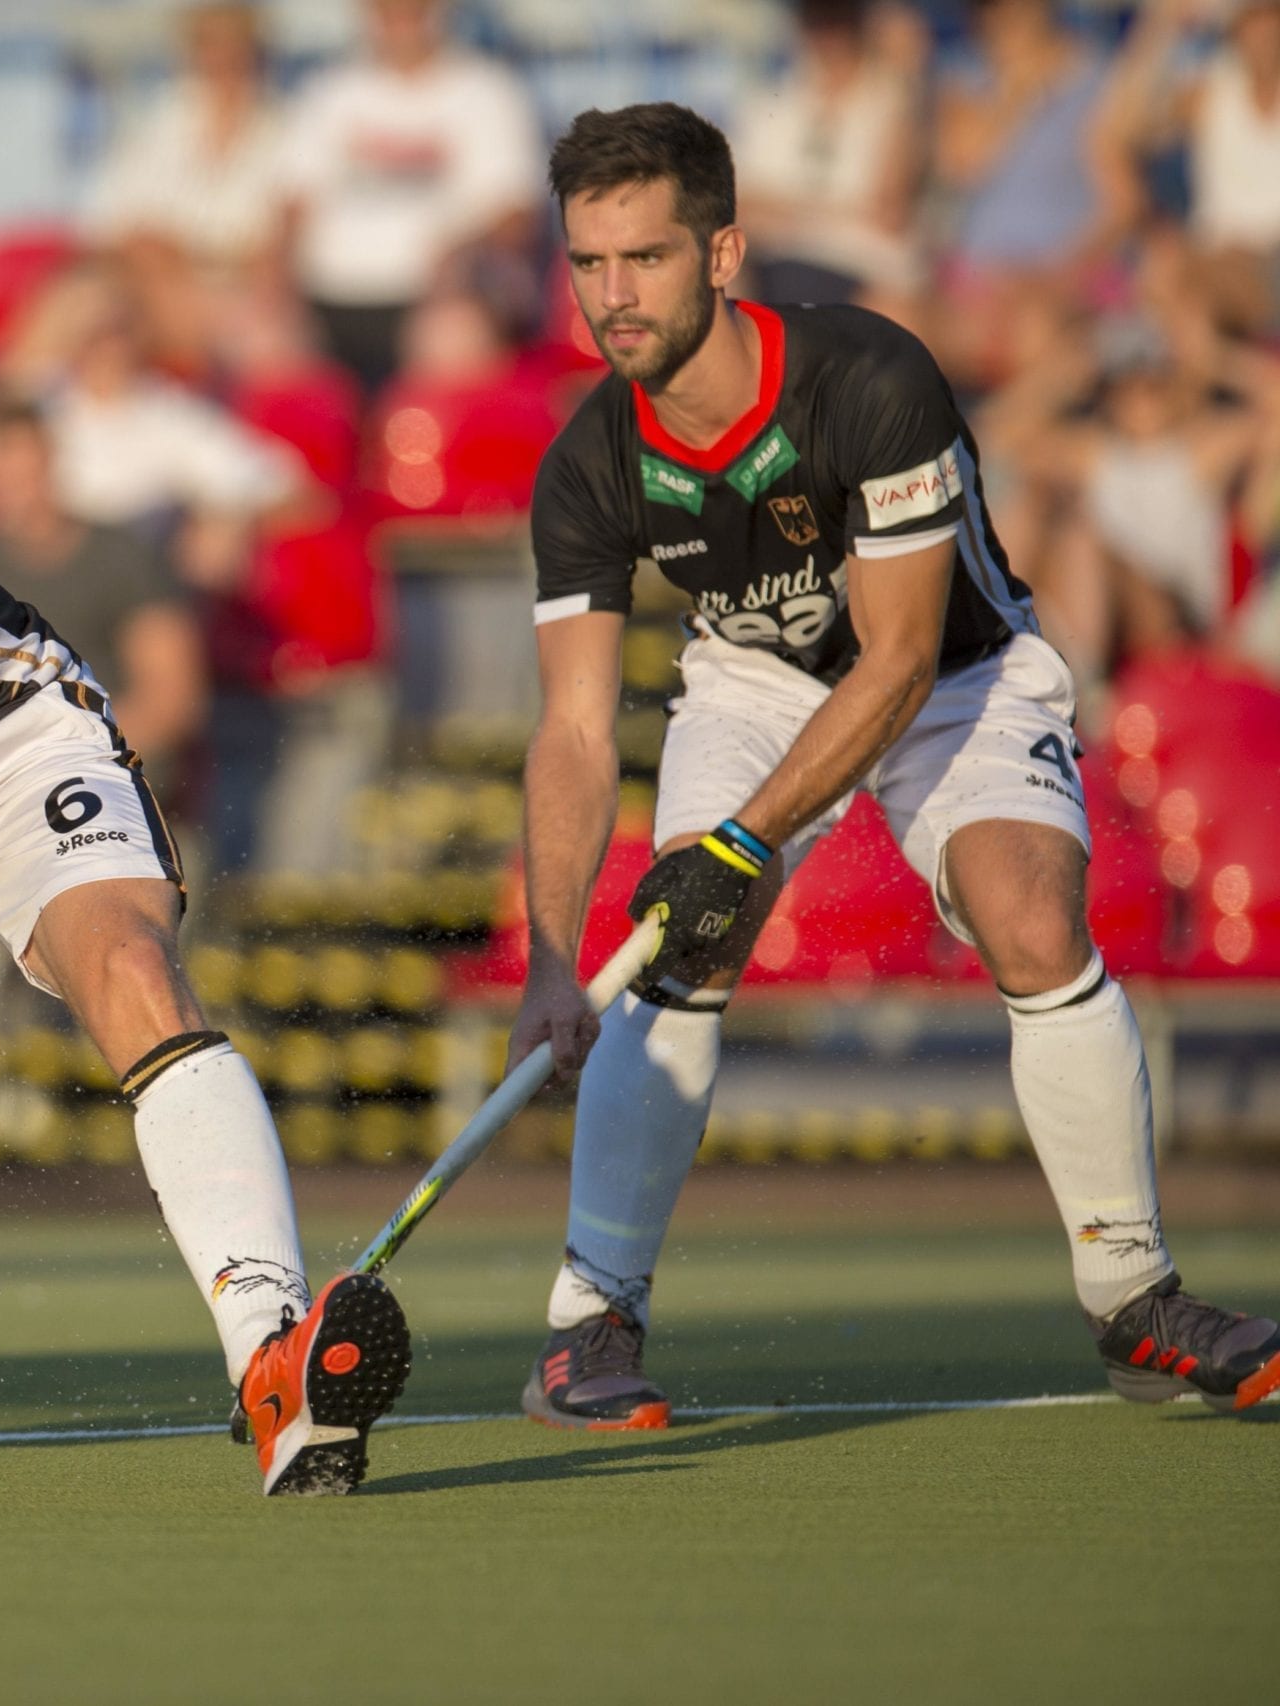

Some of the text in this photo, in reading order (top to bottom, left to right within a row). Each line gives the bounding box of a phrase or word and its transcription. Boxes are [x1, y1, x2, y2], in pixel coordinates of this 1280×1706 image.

[651, 538, 708, 561] Reece
[741, 553, 821, 610] sind
[1029, 732, 1074, 784] 4
[45, 776, 103, 834] 6
[71, 831, 129, 850] Reece
